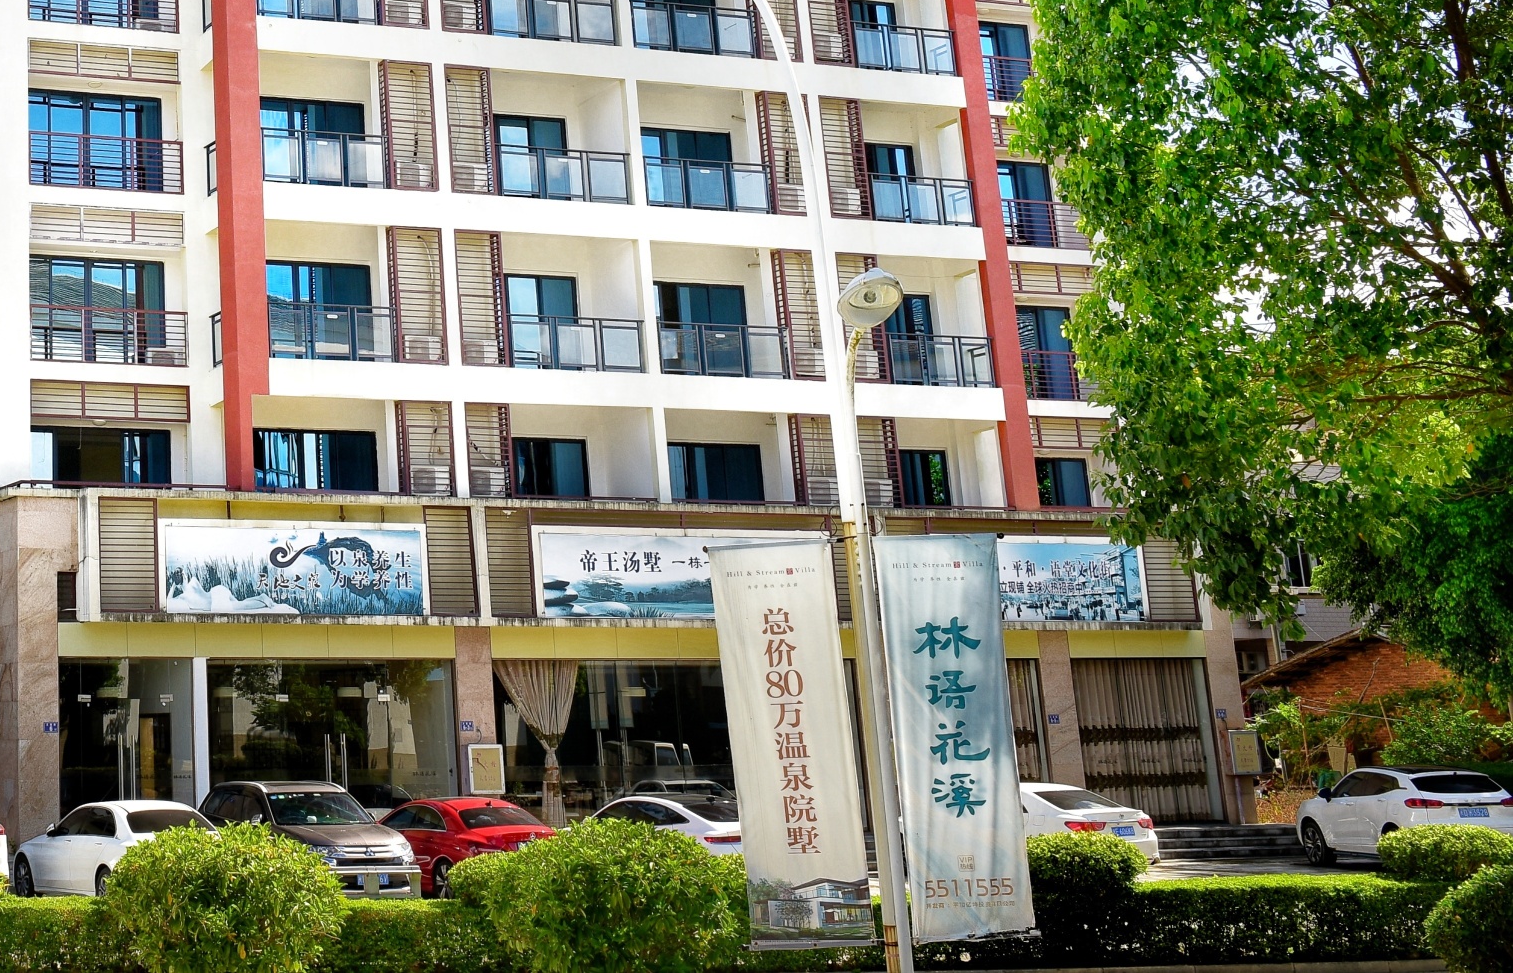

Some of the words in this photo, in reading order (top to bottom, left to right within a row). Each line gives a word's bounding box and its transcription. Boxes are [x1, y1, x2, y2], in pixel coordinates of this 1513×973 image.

[329, 548, 412, 569] 以泉养生
[579, 549, 663, 573] 帝王汤墅
[331, 570, 413, 589] 为学养性
[794, 566, 816, 574] Villa
[912, 616, 991, 818] 林语花溪
[761, 607, 822, 855] 总价80万温泉院墅
[924, 878, 1014, 899] 5511555
